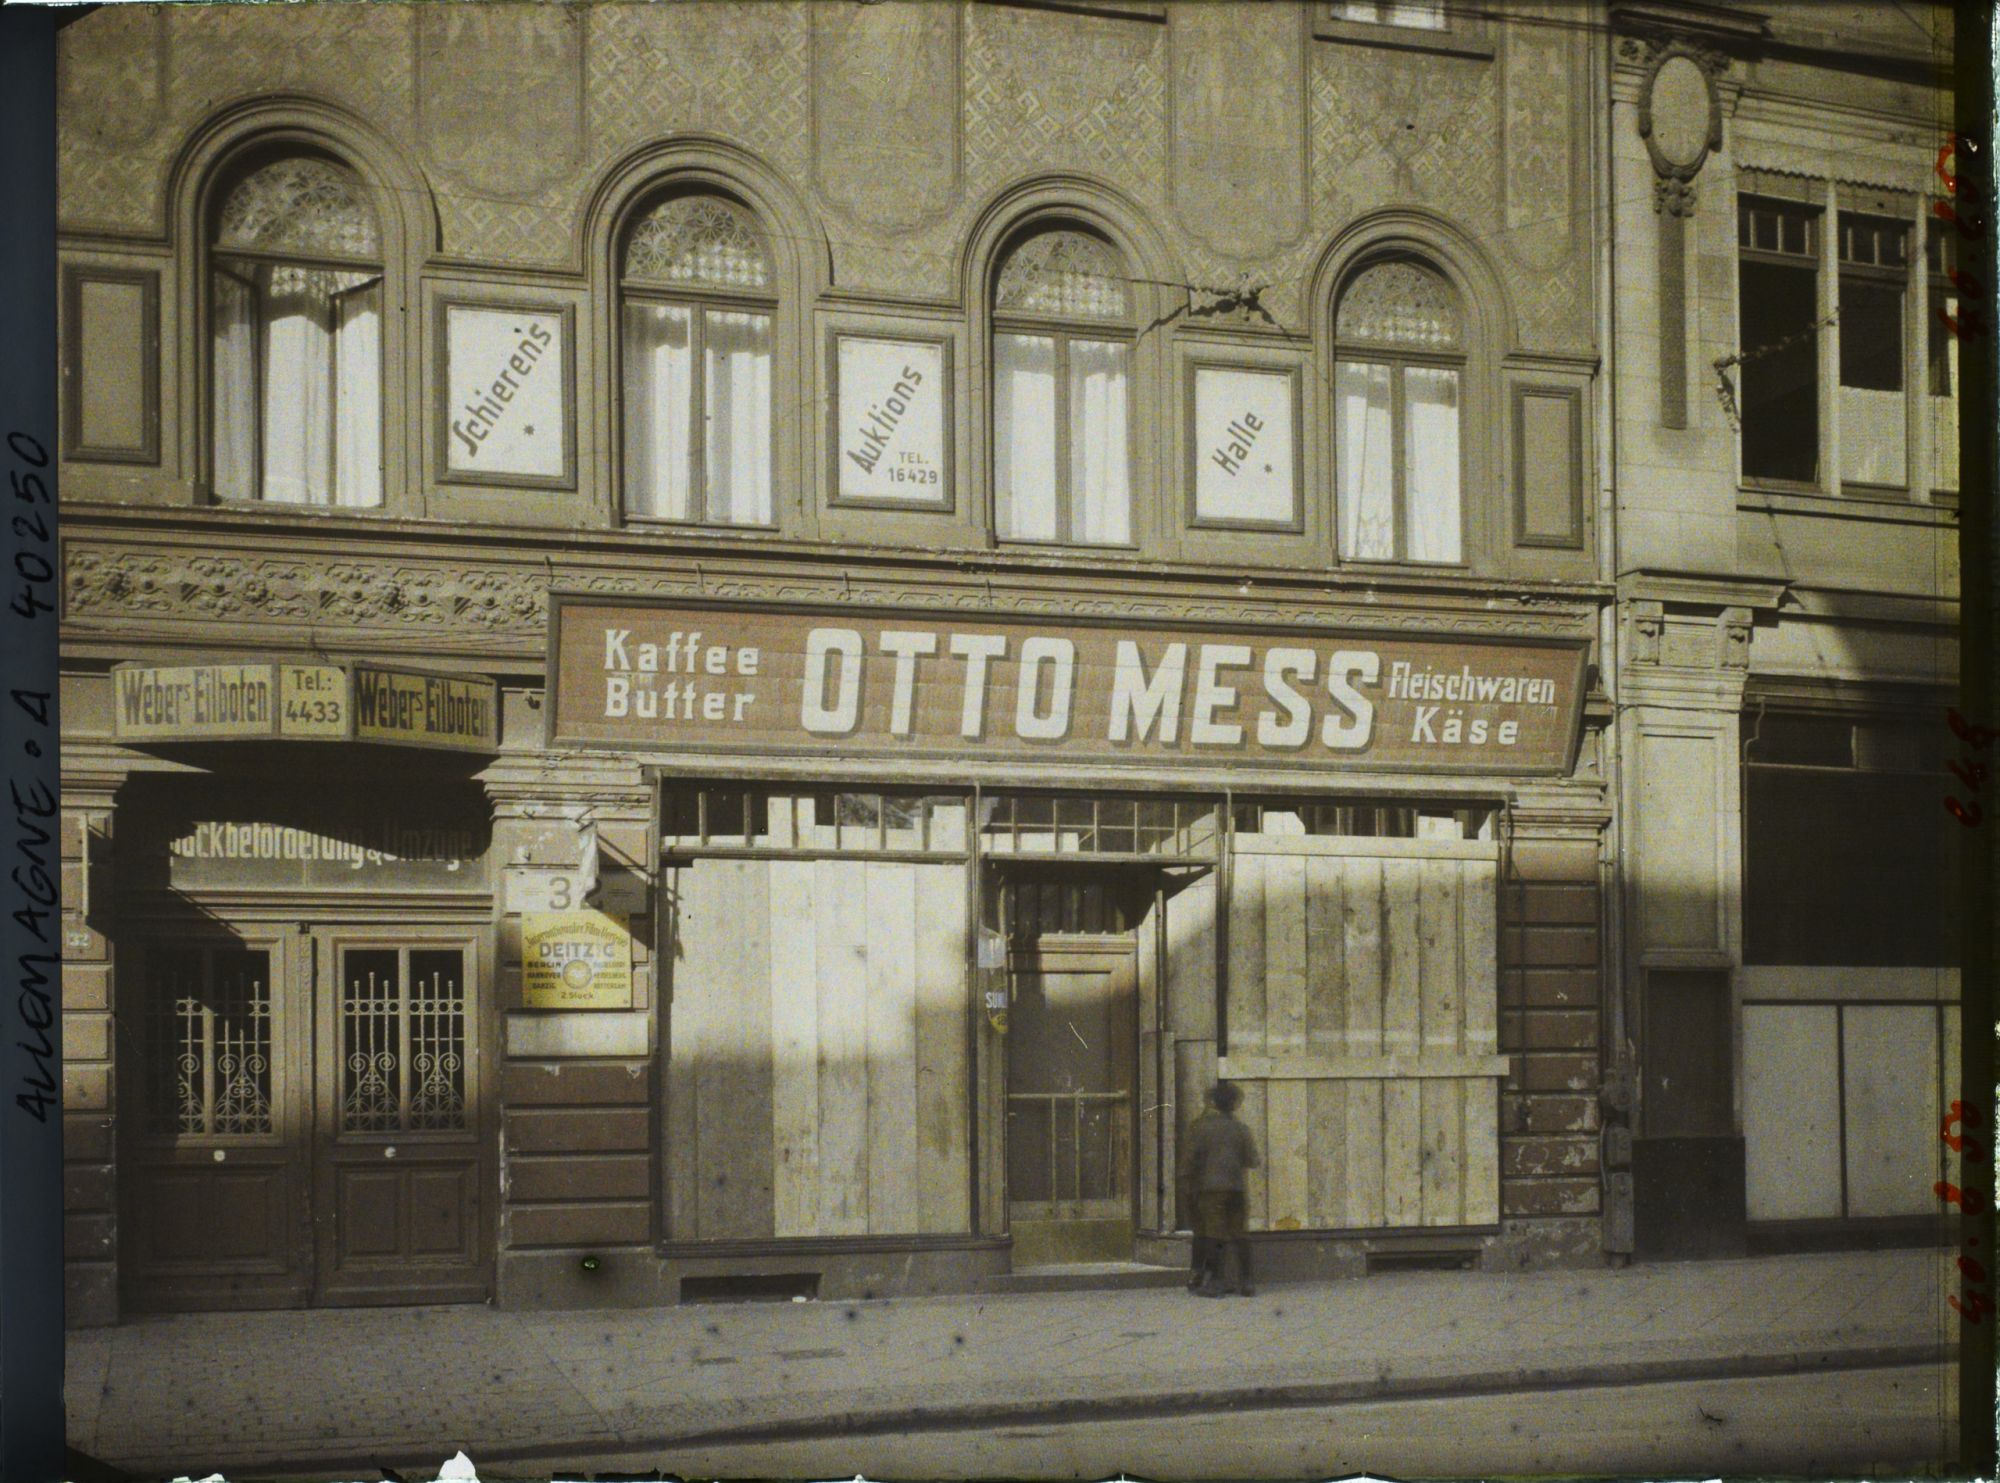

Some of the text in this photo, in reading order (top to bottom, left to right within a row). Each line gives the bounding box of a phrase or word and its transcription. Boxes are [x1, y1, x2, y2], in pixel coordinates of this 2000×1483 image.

[846, 365, 923, 475] Auktions
[899, 451, 929, 465] TEL.
[1211, 412, 1264, 477] Halle
[888, 467, 938, 485] 16429
[604, 628, 760, 675] Kaffee
[193, 668, 268, 724] Eilboten
[292, 669, 332, 691] Tel.:
[603, 677, 755, 722] Butter
[800, 627, 1382, 750] OTTO MESS
[1388, 661, 1556, 705] Fleischwaren
[285, 700, 340, 723] 4433
[425, 677, 489, 737] Eilboten
[1410, 705, 1519, 746] Käse
[7, 430, 60, 1123] ALLEMAGNE A 40250
[540, 942, 594, 958] DEITZ
